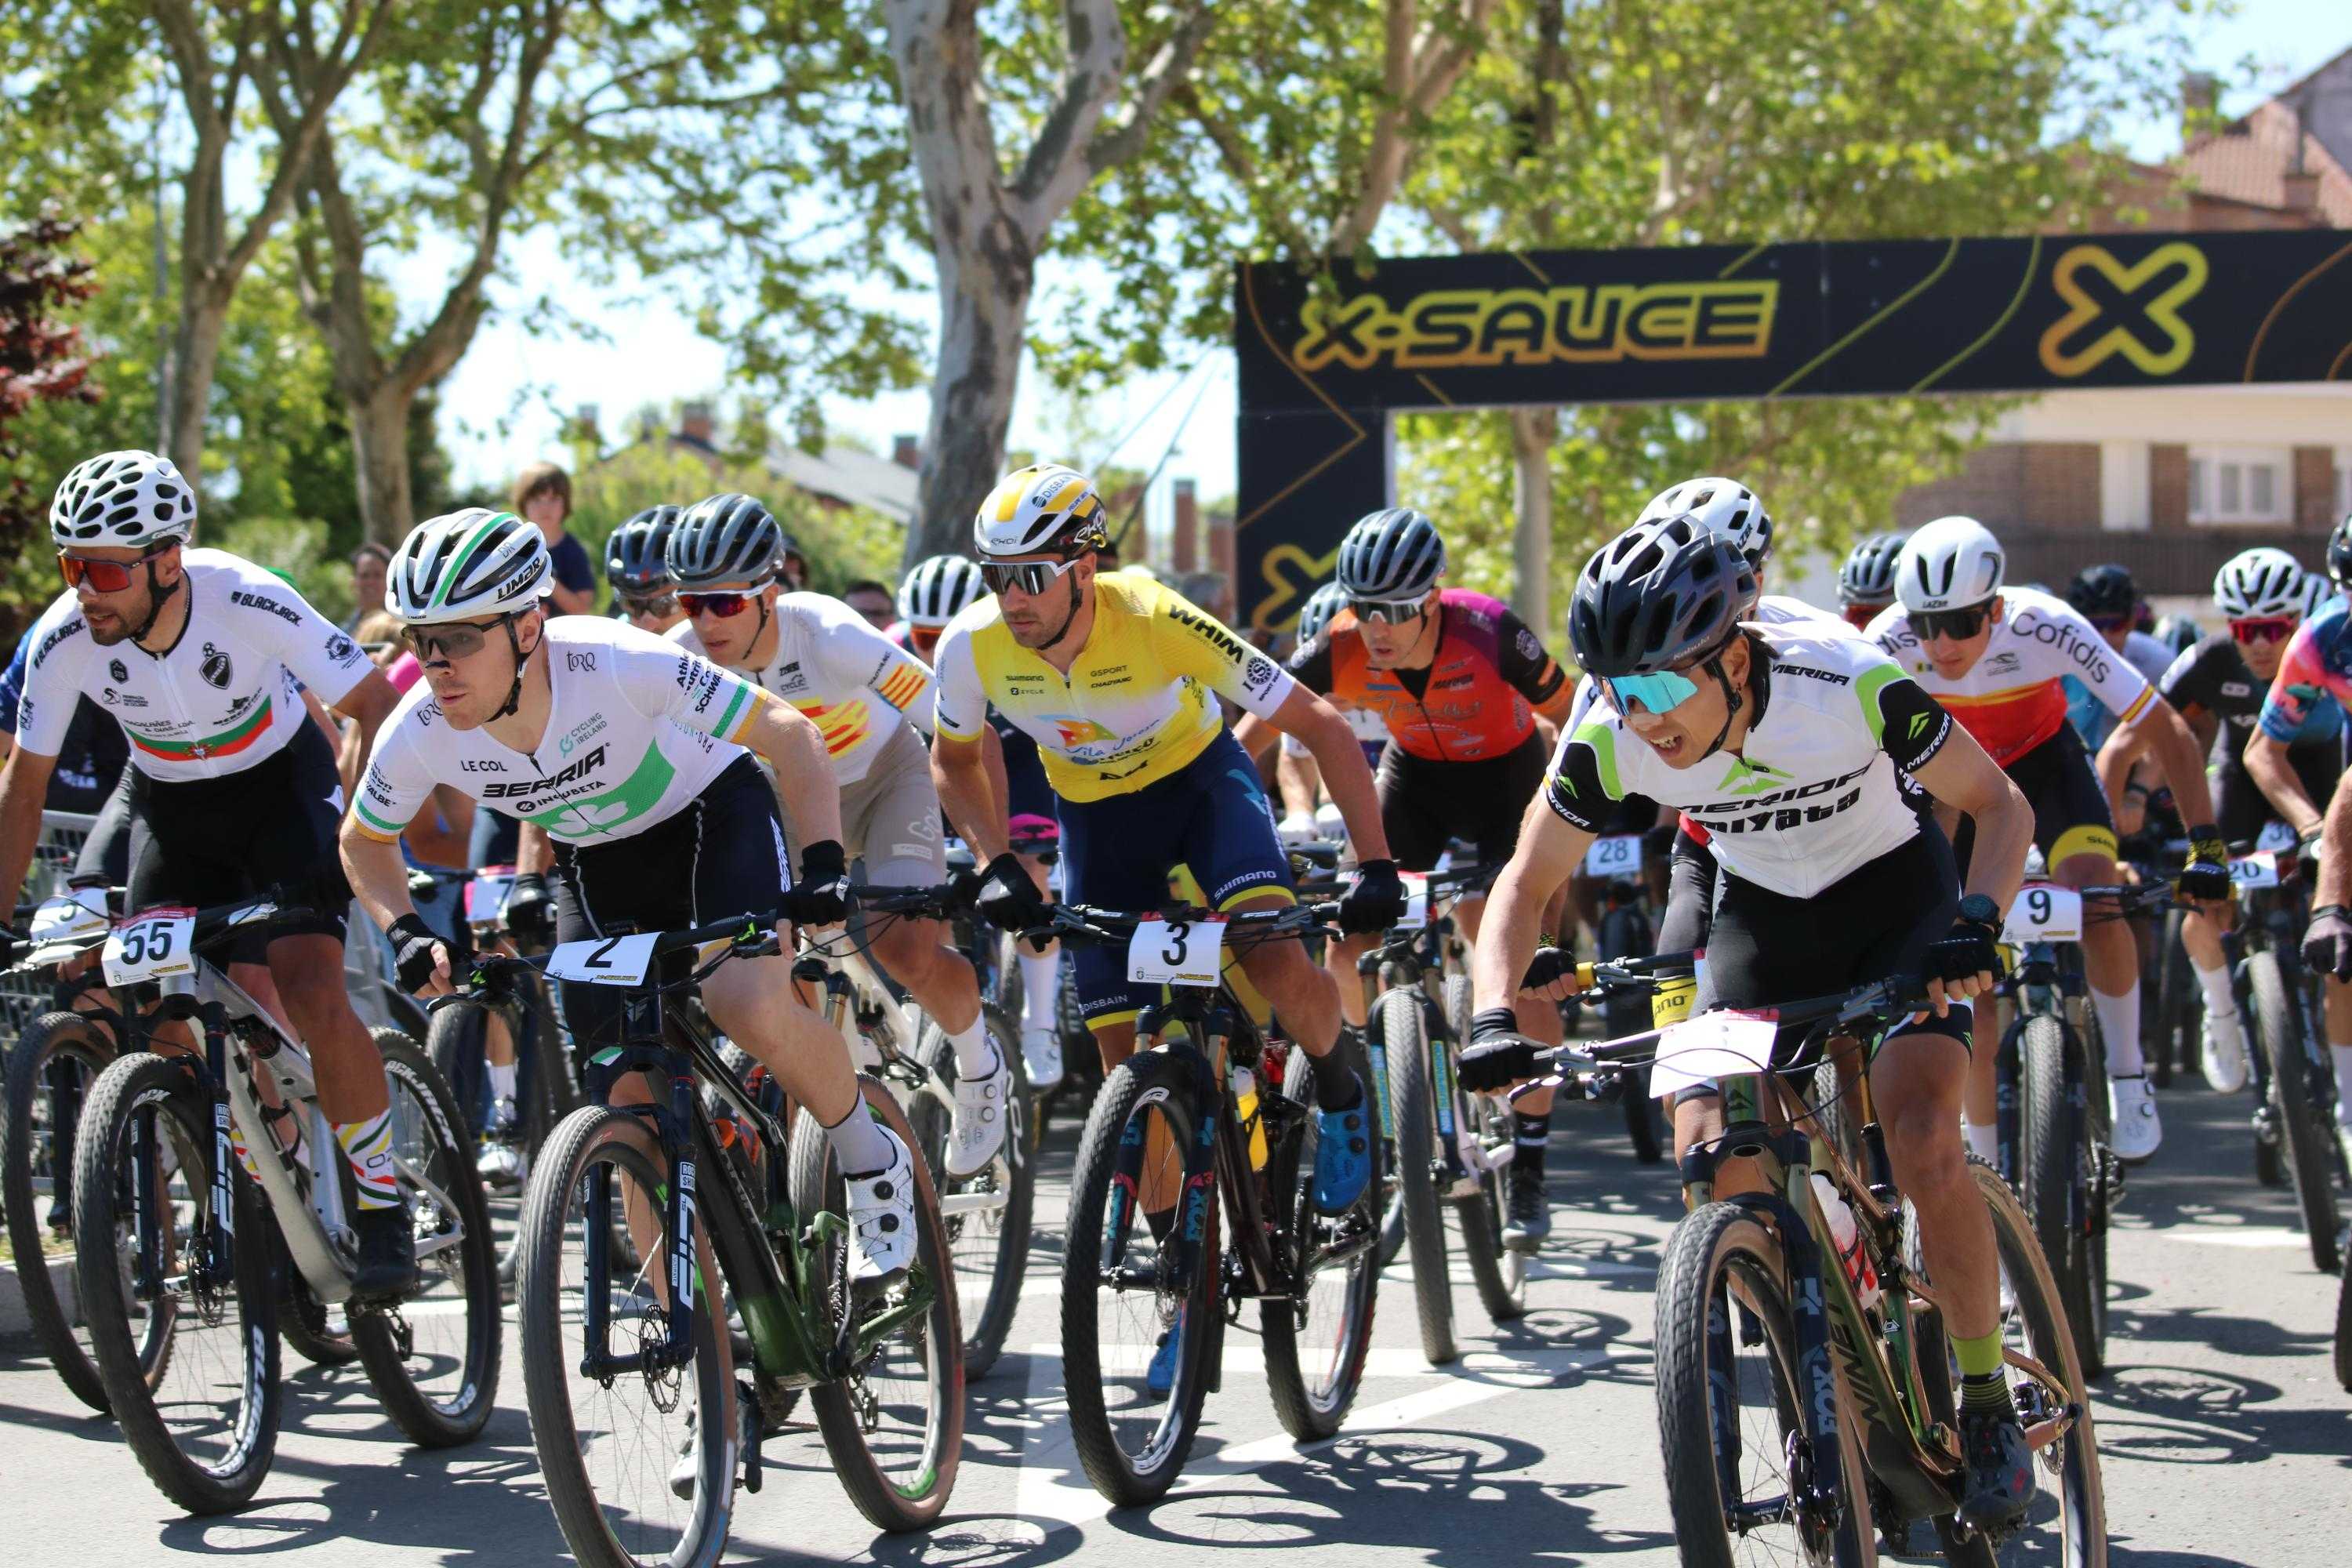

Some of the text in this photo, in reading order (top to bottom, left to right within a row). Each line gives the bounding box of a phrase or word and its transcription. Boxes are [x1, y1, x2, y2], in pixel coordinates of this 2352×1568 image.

[1293, 281, 1779, 371] X-SAUCE
[1169, 604, 1244, 664] WHIM
[2011, 612, 2111, 684] Cofidis
[1771, 664, 1850, 686] MERIDA
[571, 712, 603, 738] CYCLING
[575, 720, 608, 745] IRELAND
[1907, 712, 1951, 771] MERIDA
[461, 760, 508, 771] LE COL
[1598, 839, 1628, 863] 28
[1214, 870, 1277, 900] SHIMANO
[2027, 889, 2052, 925] 9
[121, 921, 175, 966] 55
[584, 935, 623, 968] 2
[1162, 921, 1190, 966] 3
[1084, 993, 1129, 1012] DISBAIN
